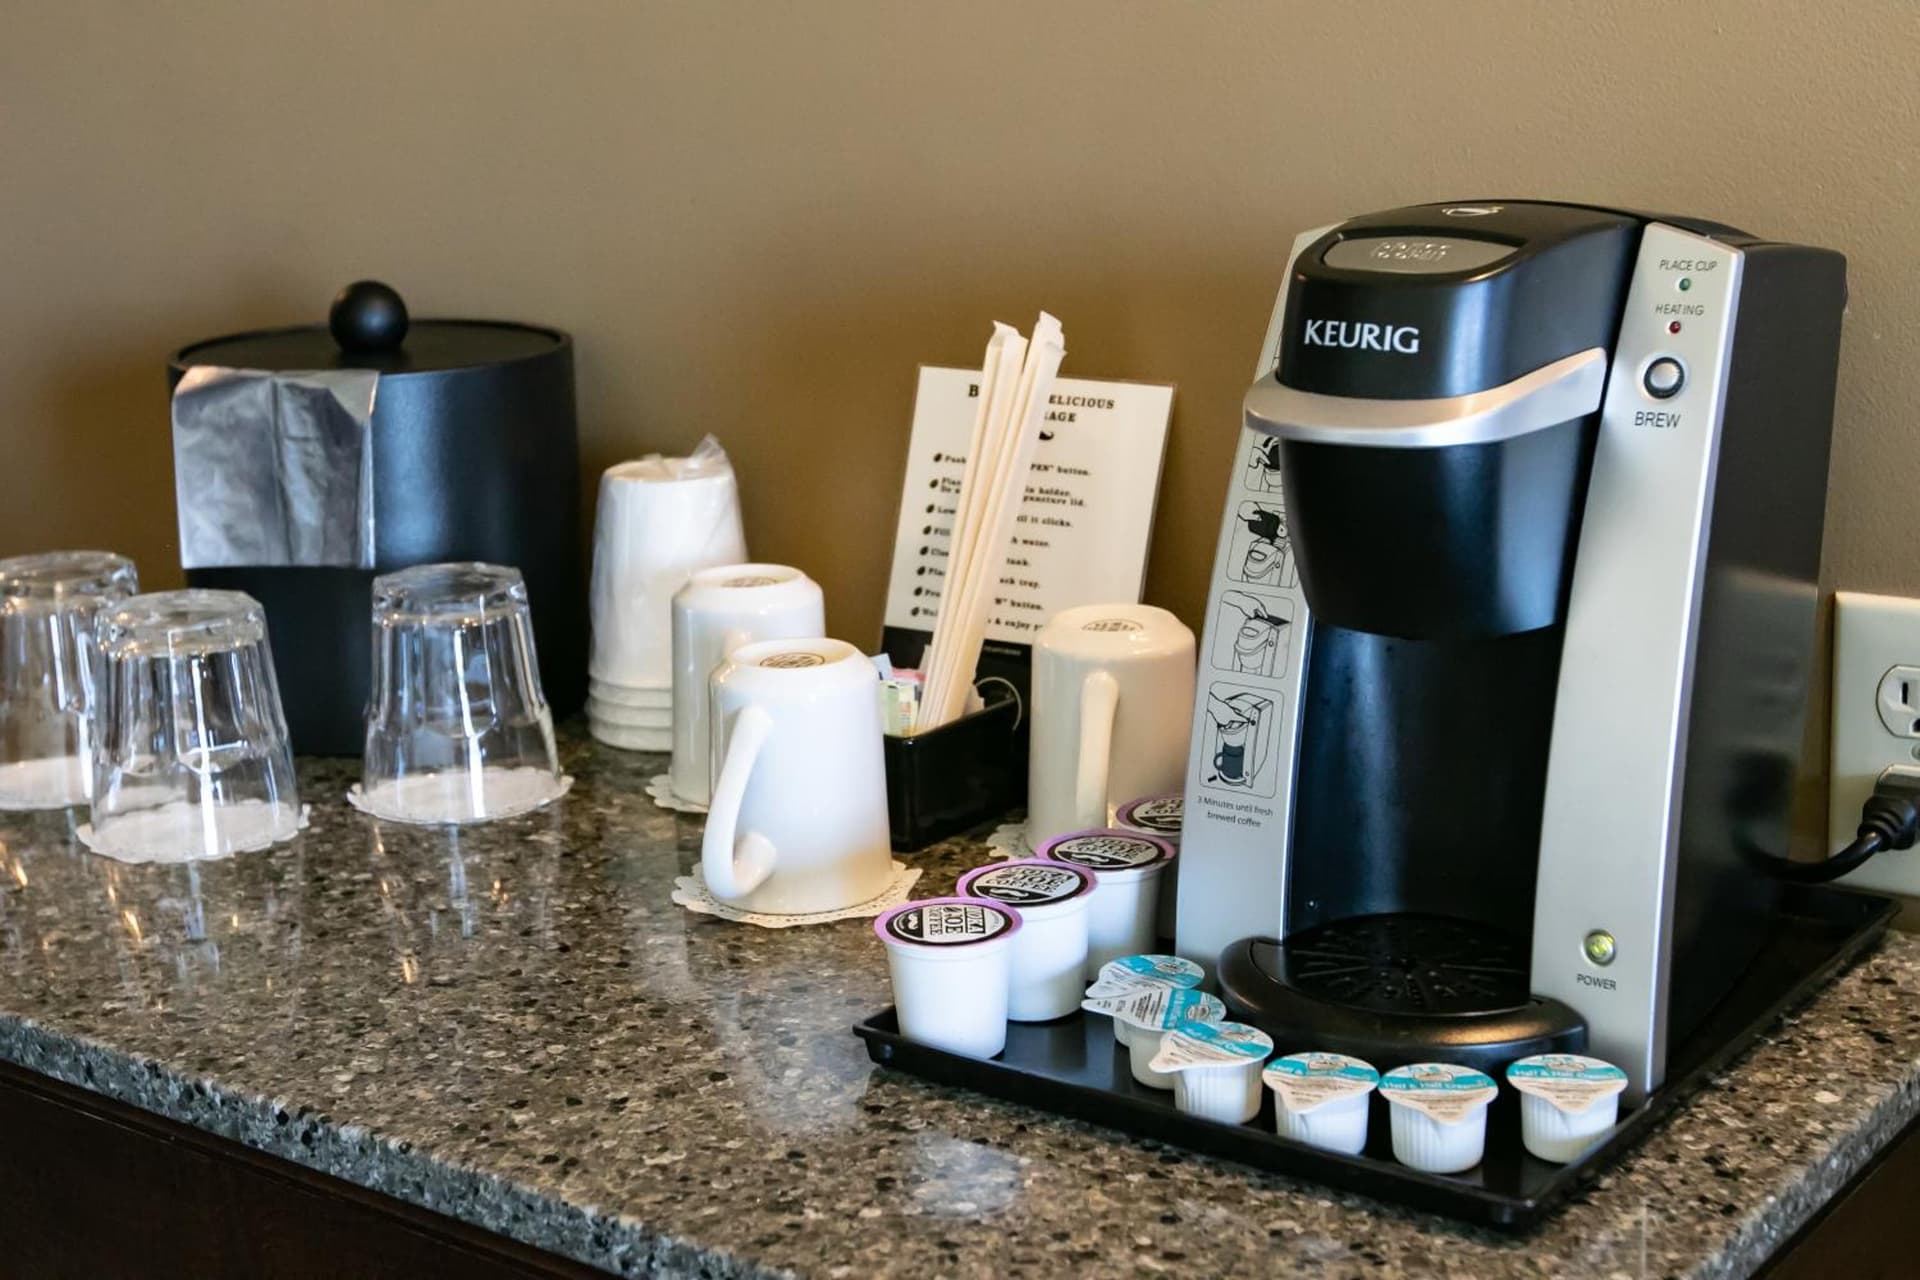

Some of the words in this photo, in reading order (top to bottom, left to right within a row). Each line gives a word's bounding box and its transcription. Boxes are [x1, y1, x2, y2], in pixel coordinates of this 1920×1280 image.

[1659, 259, 1693, 271] PLACE
[1695, 260, 1718, 271] CUP
[1655, 304, 1705, 315] HEATING
[1304, 319, 1420, 354] KEURIG
[1048, 394, 1115, 409] ELICIOUS
[1634, 411, 1681, 429] BREW
[1030, 463, 1054, 471] PEN"
[941, 477, 962, 485] Plac
[1204, 797, 1234, 809] Minutes
[1207, 810, 1236, 823] brewed
[1576, 973, 1617, 990] POWER
